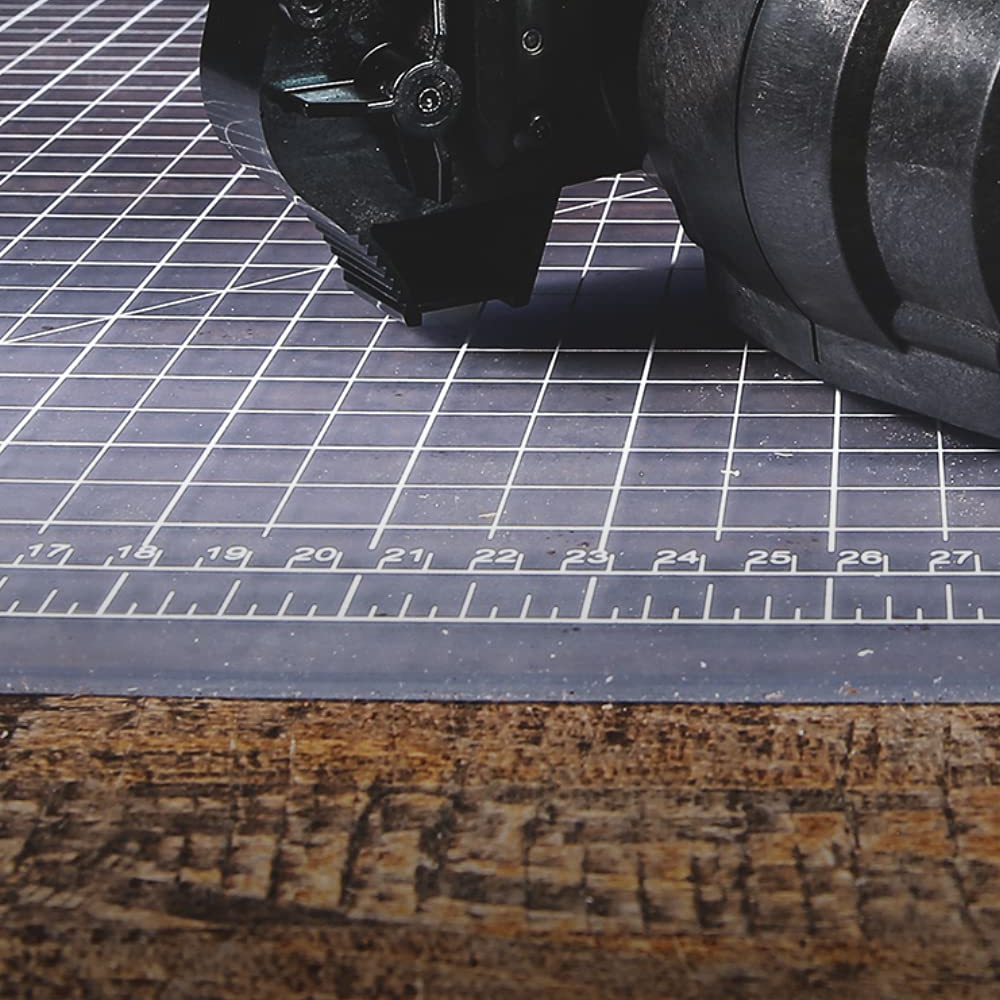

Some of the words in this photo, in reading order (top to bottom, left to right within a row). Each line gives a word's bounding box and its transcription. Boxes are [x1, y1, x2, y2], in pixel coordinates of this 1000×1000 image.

[27, 543, 72, 558] 17
[117, 544, 159, 560] 18
[206, 545, 249, 561] 19
[291, 546, 338, 562] 20
[380, 547, 425, 563] 21
[473, 548, 519, 564] 22
[564, 549, 610, 565] 23
[654, 549, 701, 565] 24
[746, 549, 793, 565] 25
[837, 549, 885, 565] 26
[929, 549, 975, 565] 27
